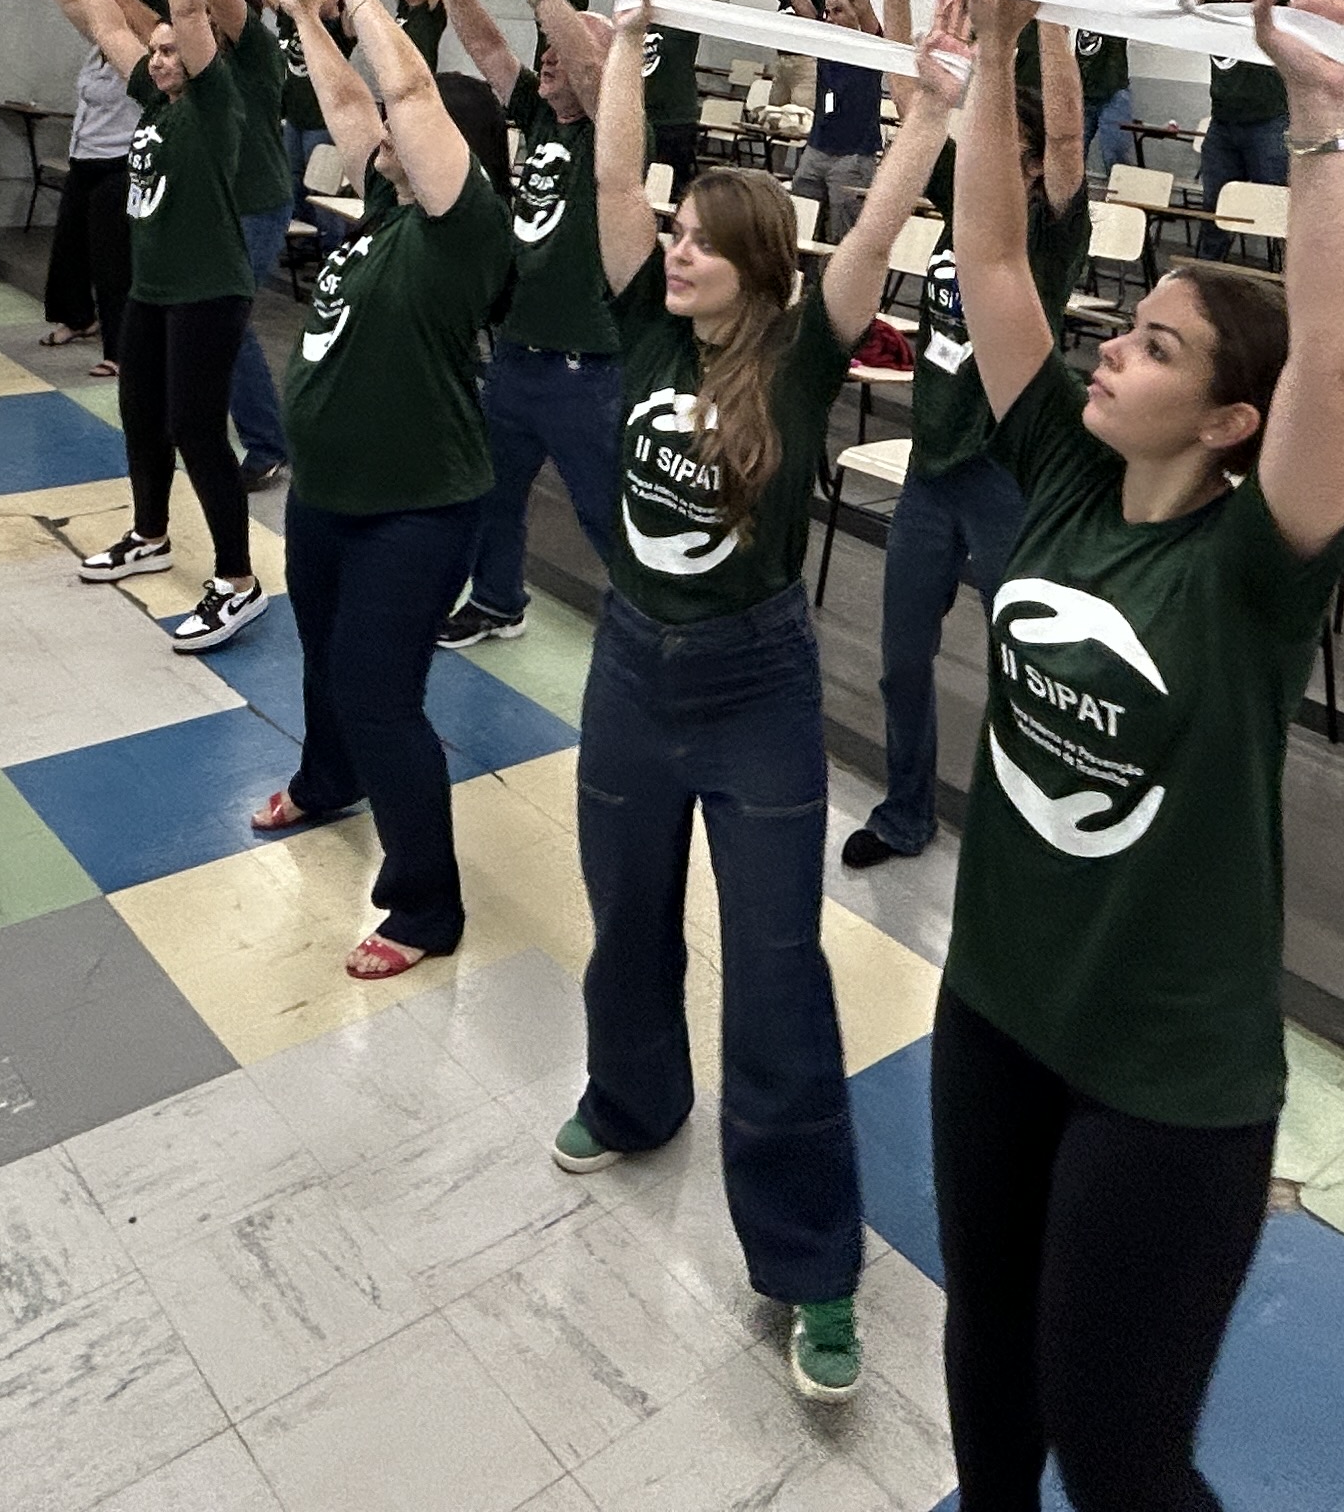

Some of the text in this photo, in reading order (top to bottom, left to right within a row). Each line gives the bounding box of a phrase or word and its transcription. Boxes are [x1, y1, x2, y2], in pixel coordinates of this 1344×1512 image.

[635, 434, 652, 462] II
[1000, 643, 1126, 738] II SIPAT
